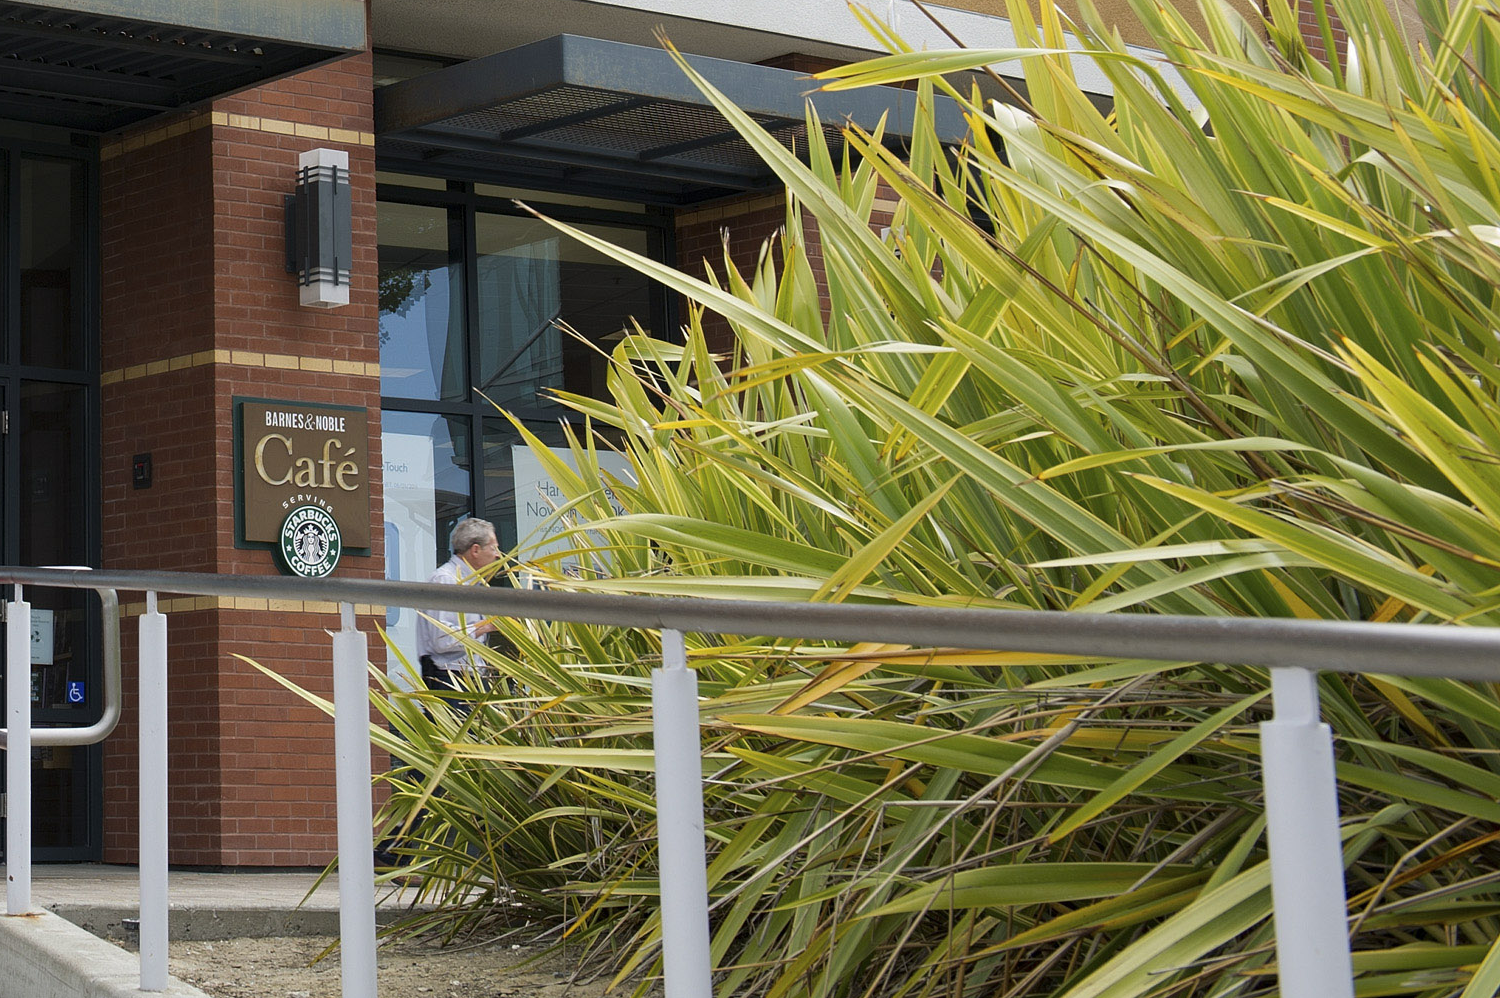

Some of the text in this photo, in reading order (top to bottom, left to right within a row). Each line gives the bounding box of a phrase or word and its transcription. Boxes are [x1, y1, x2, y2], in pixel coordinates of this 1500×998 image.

[254, 433, 360, 491] Café
[384, 461, 408, 473] Touch
[282, 494, 334, 513] SERVING
[285, 509, 338, 542] STARBUCKS
[291, 556, 331, 576] COFFEE
